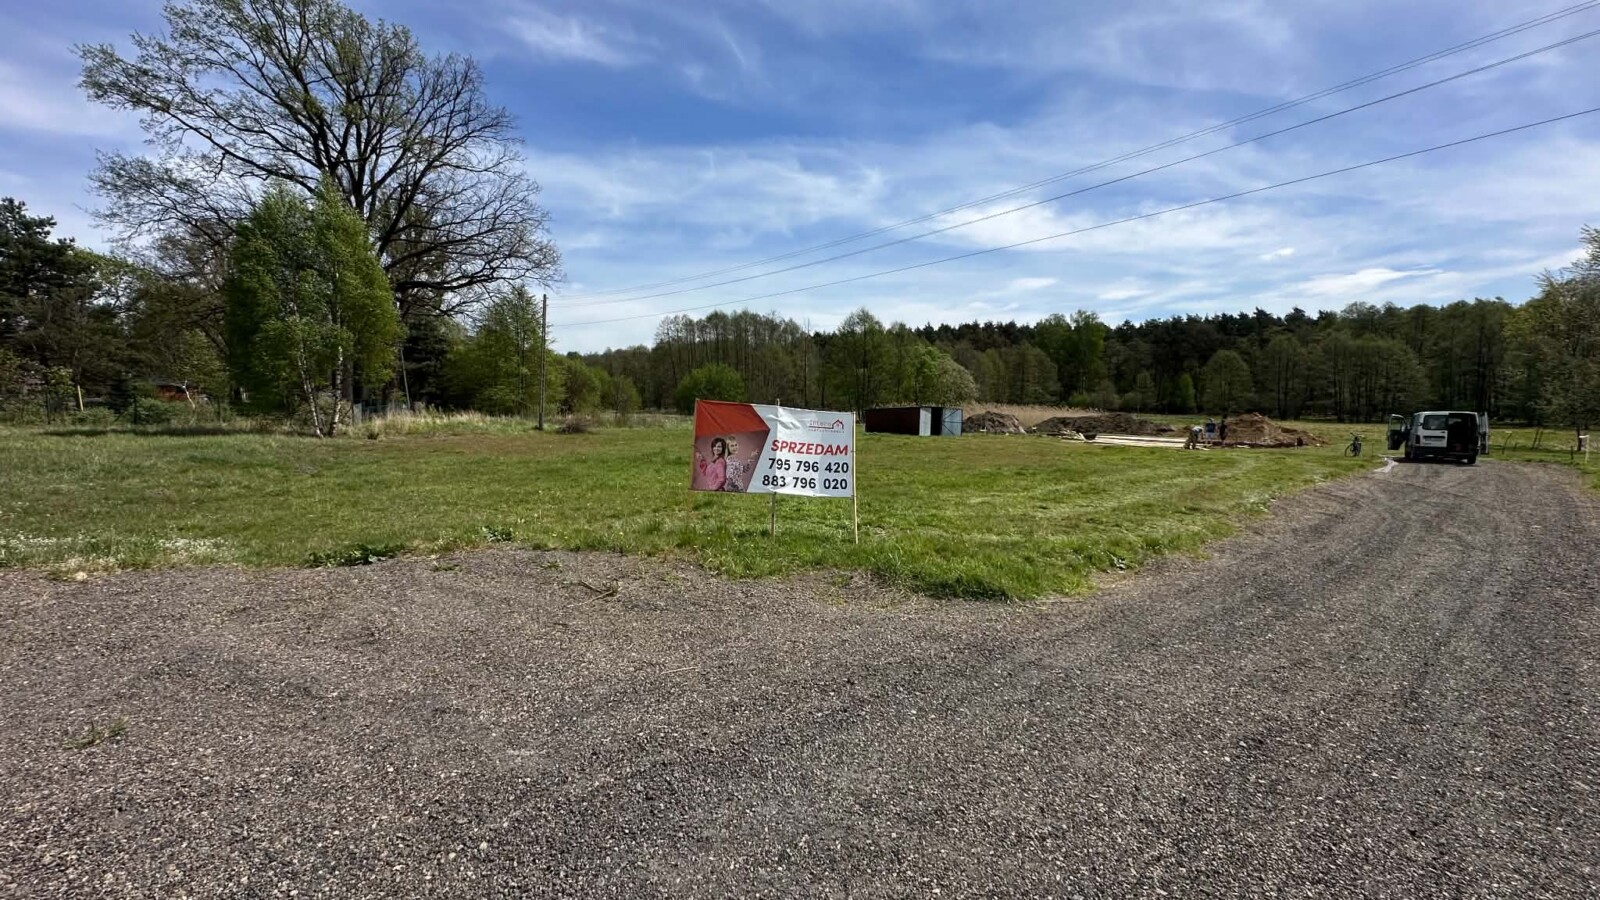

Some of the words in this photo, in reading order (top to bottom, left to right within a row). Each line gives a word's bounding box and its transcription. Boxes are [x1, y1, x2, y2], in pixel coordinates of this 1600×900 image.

[770, 439, 849, 456] SPRZEDAM
[768, 457, 791, 471] 795
[795, 460, 819, 473] 796
[824, 462, 849, 473] 420
[762, 475, 786, 487] 883
[792, 477, 817, 489] 796
[823, 478, 848, 490] 020
